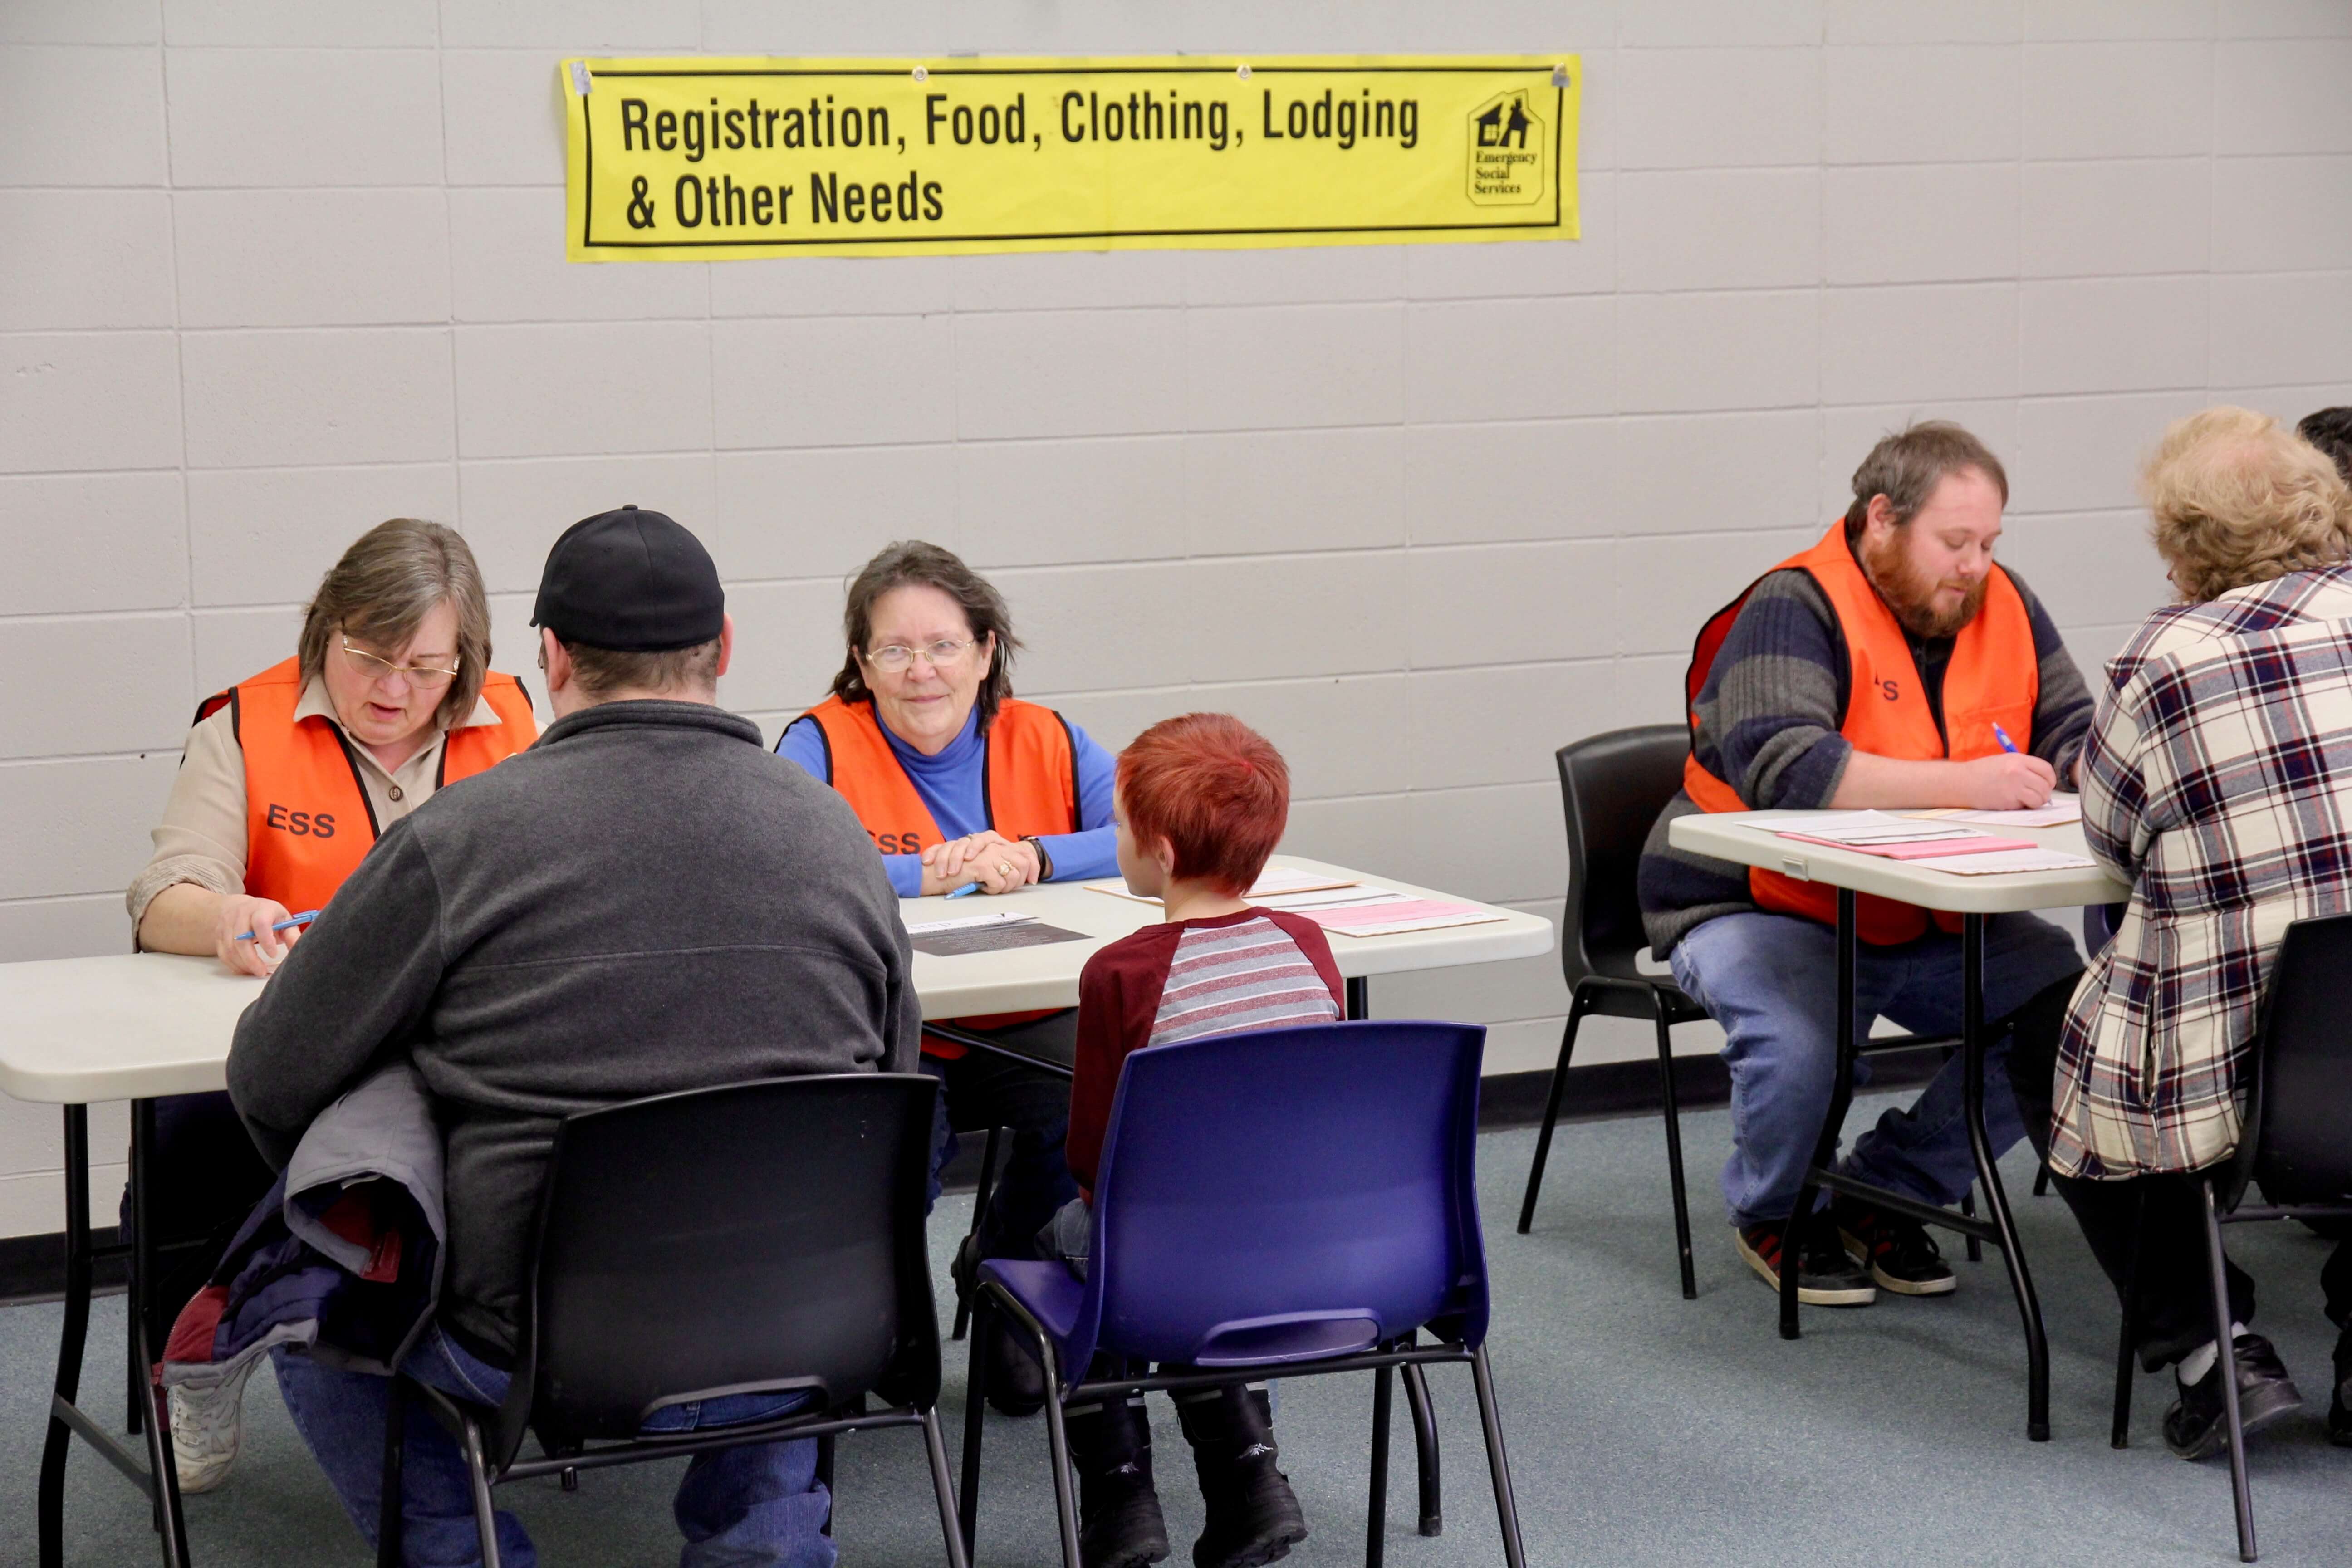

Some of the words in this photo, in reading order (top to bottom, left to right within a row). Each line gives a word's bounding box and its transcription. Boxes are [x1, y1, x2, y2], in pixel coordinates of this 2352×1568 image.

[621, 95, 905, 163] Registration,
[926, 93, 1041, 151] Food,
[1062, 91, 1243, 151] Clothing,
[1264, 89, 1418, 149] Lodging
[1476, 150, 1537, 165] Emergency
[1476, 166, 1509, 179] Social
[1475, 181, 1521, 193] Services
[627, 176, 656, 229] &
[675, 171, 793, 228] Other
[810, 171, 943, 224] Needs
[267, 803, 335, 838] ESS
[867, 830, 921, 855] SS
